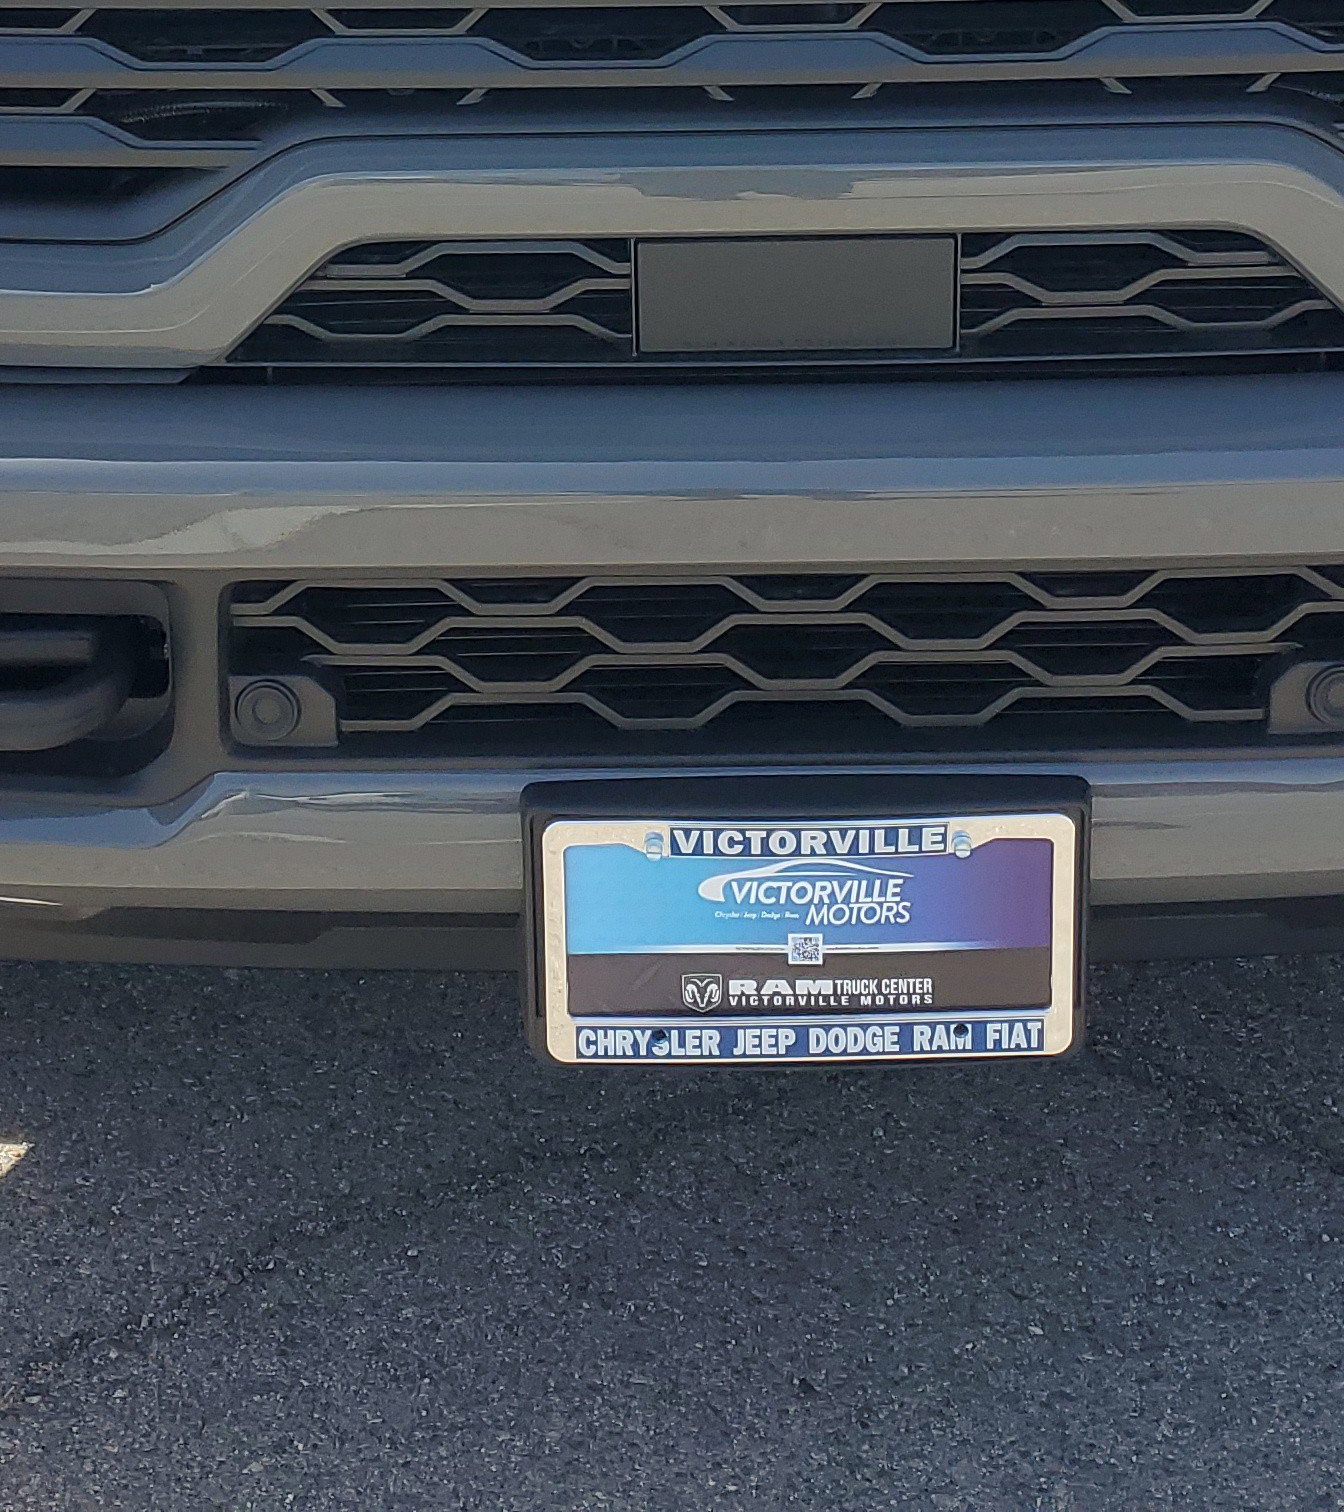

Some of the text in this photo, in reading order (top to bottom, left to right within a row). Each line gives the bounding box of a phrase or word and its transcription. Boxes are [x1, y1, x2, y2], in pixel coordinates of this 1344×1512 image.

[672, 826, 946, 855] VICTORVILLE
[731, 878, 904, 905] VICTORVILLE
[805, 902, 911, 926] MOTORS
[728, 977, 933, 995] RAM TRUCK CENTER
[729, 994, 933, 1006] VICTORVILLE MOTORS
[732, 1028, 796, 1056] JEEP
[808, 1025, 900, 1054] DODGE
[913, 1023, 973, 1051] RAM
[986, 1021, 1042, 1050] FIAT
